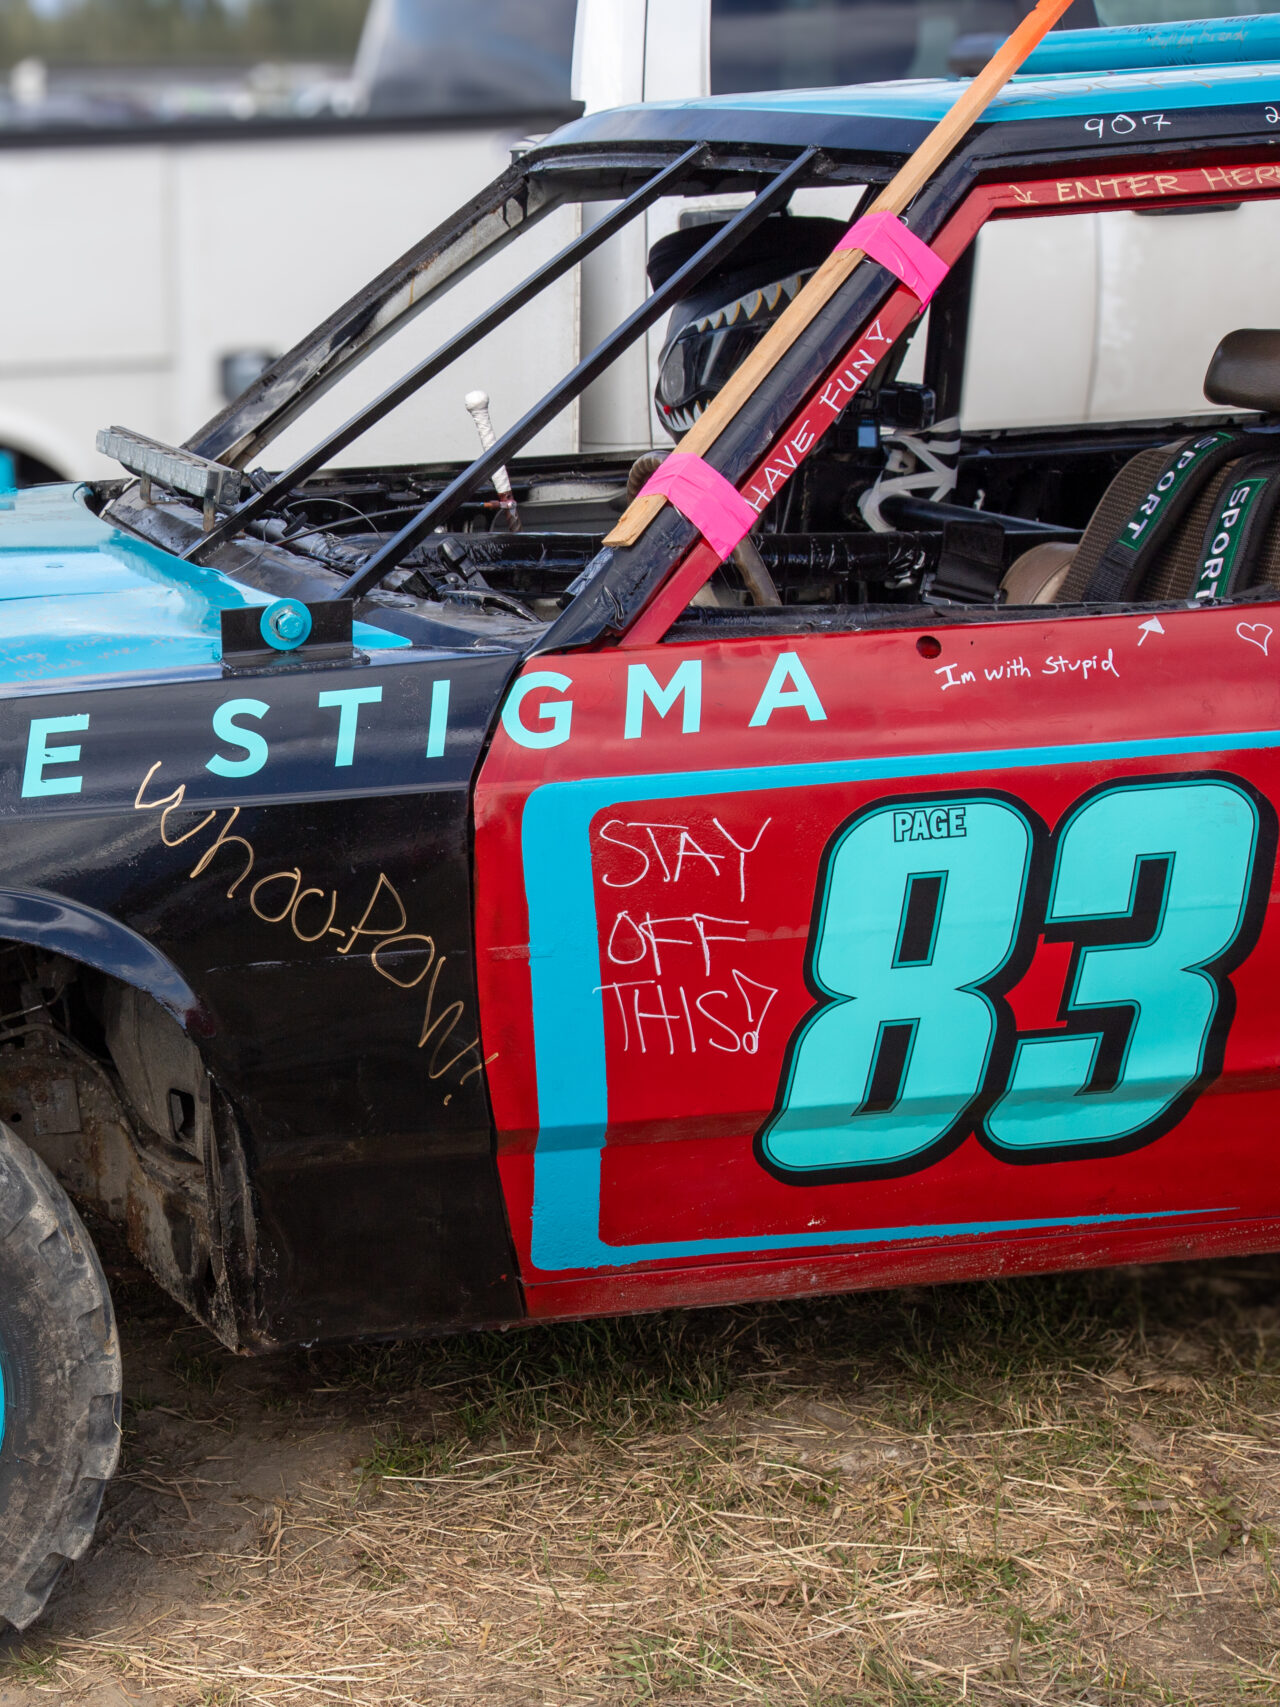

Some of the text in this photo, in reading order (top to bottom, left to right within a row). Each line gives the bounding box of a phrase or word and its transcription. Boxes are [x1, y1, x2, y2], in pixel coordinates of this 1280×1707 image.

[1084, 113, 1172, 139] 907
[1055, 165, 1280, 203] ENTER HER
[744, 419, 815, 514] HAVE
[1127, 435, 1219, 541] SPORT
[1194, 485, 1251, 599] SPORT
[984, 656, 1032, 682] with
[1041, 647, 1120, 681] Stupid
[205, 651, 828, 779] STIGMA
[599, 816, 772, 903] STAY
[893, 806, 967, 842] PAGE
[607, 910, 750, 977] OFF
[754, 772, 1275, 1186] 83
[591, 967, 779, 1056] THIS!
